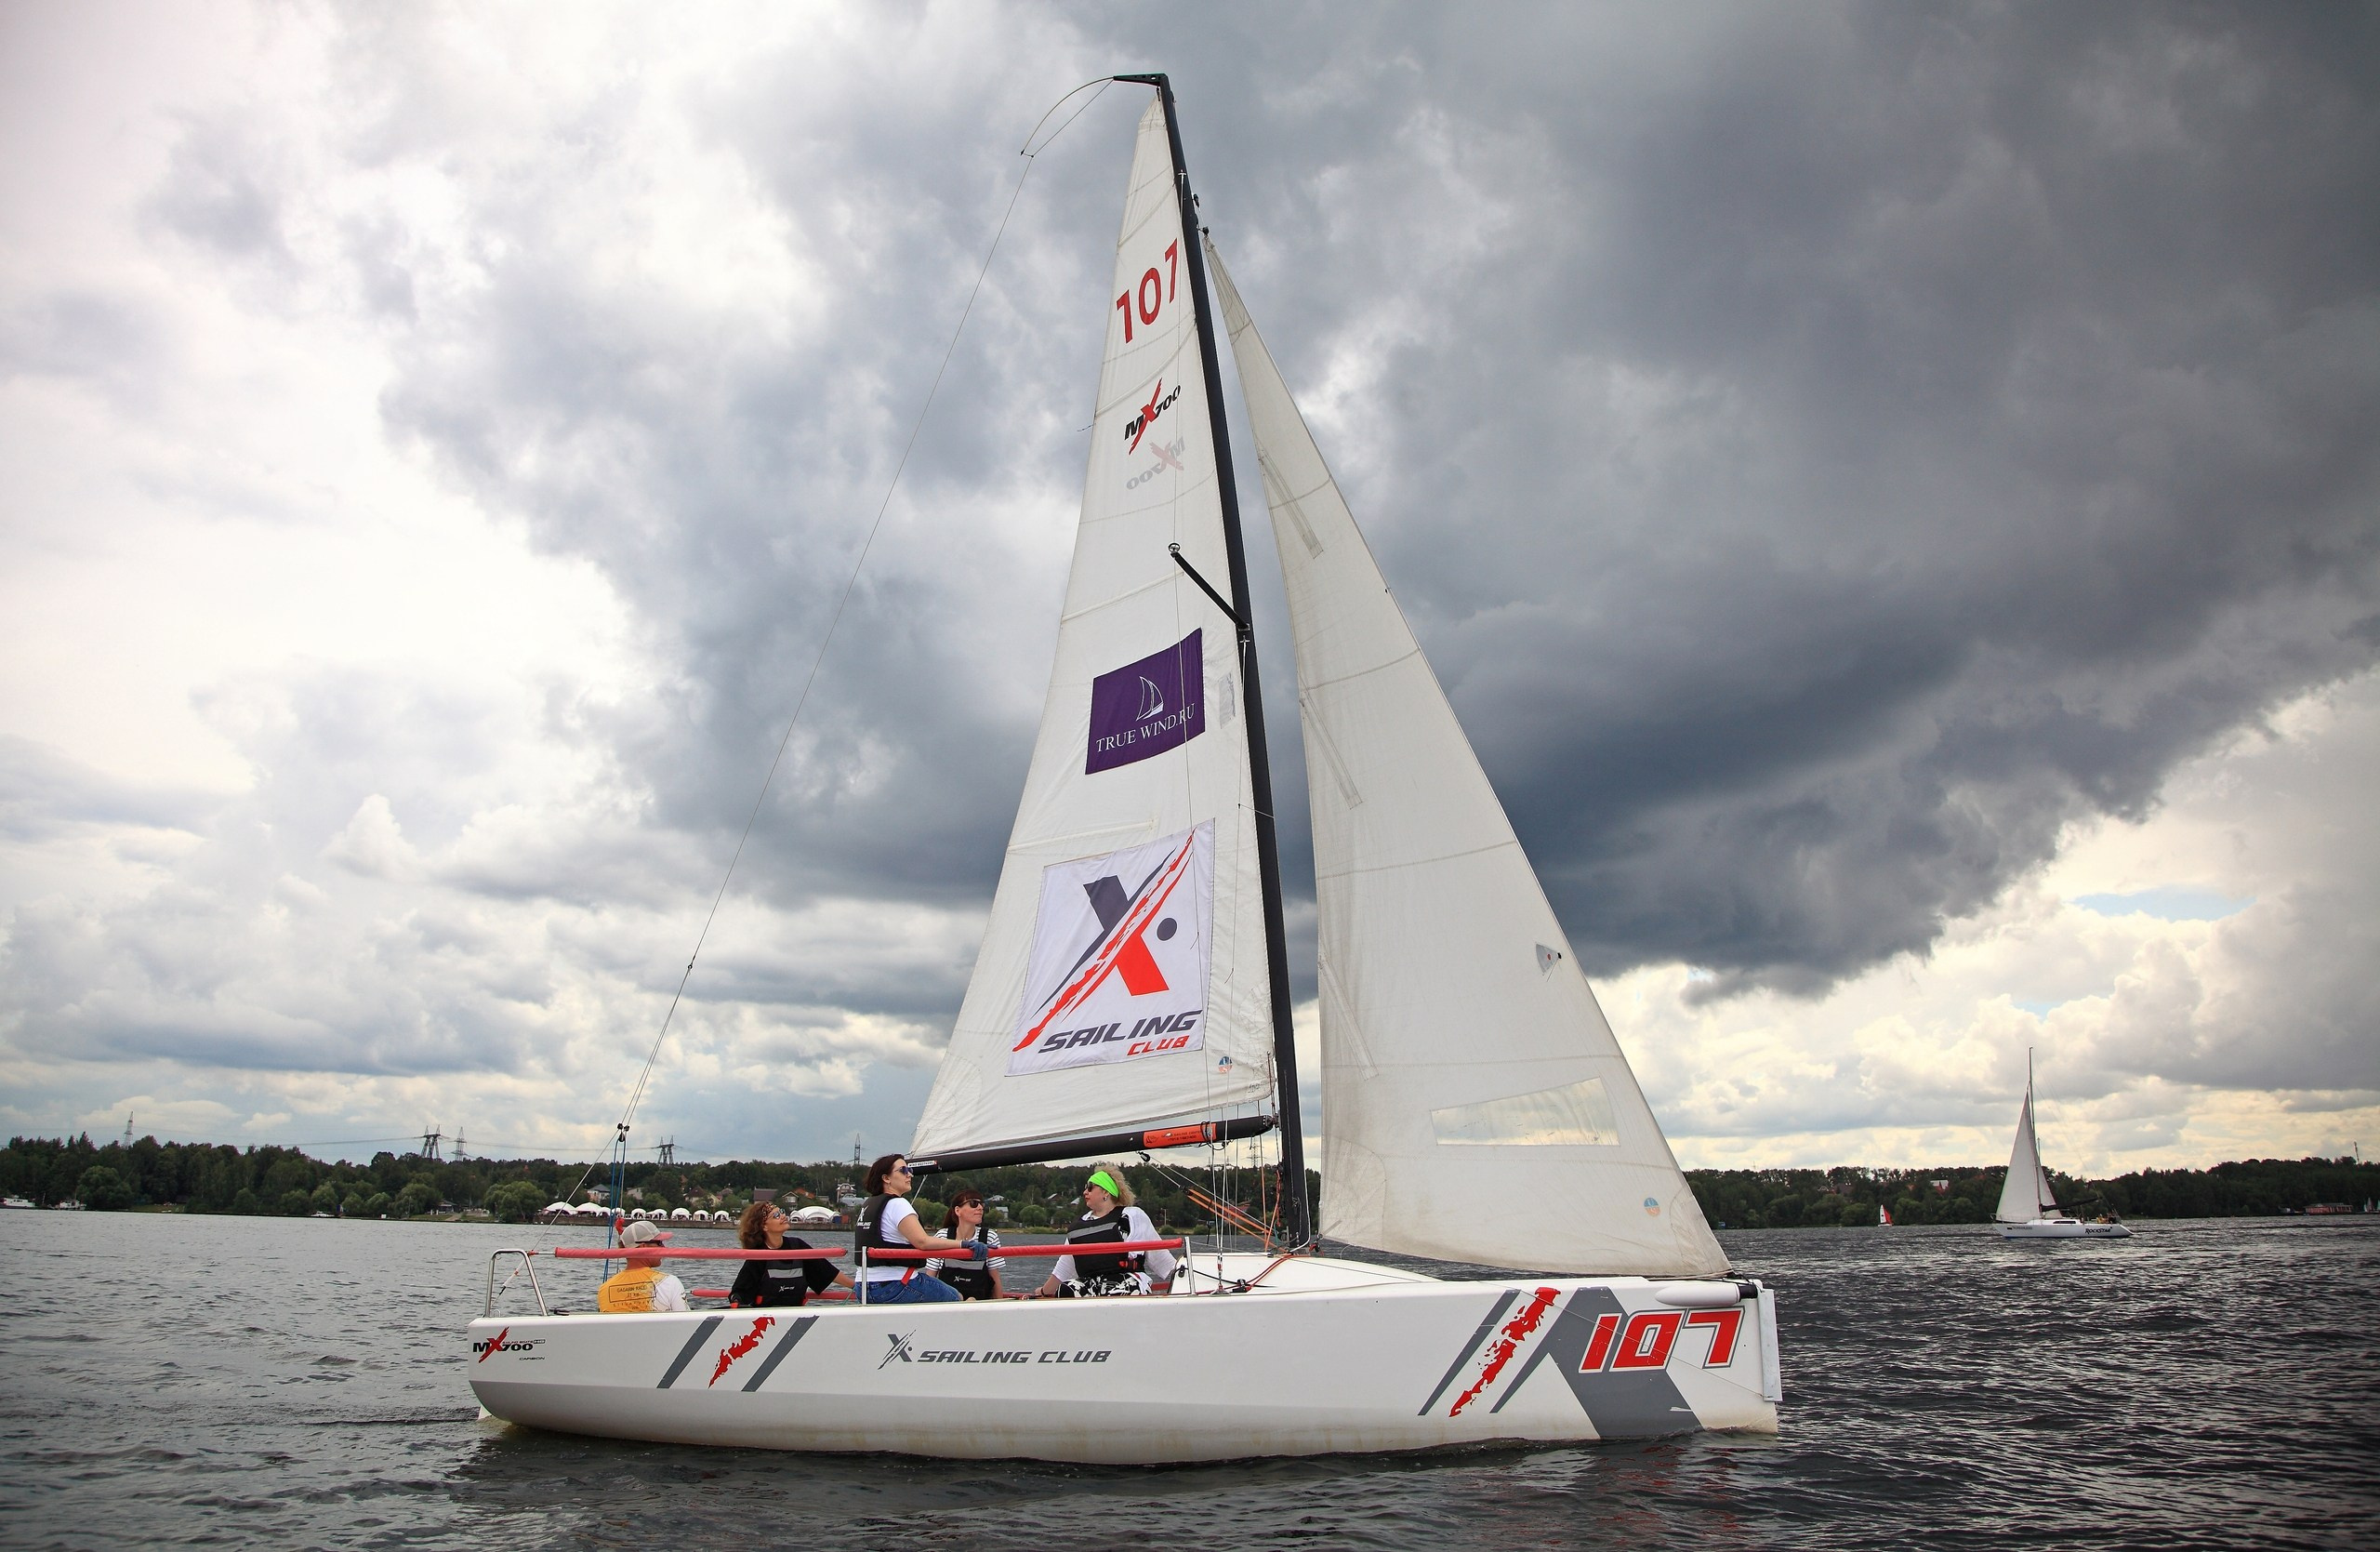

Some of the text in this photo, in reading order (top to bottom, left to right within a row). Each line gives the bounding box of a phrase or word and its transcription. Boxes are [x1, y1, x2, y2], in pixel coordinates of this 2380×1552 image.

[1116, 237, 1178, 344] 107
[1123, 377, 1182, 456] MX700
[1095, 703, 1196, 752] TRUE WIND.RU
[1038, 1009, 1203, 1055] SAILING
[1127, 1035, 1190, 1056] CLUB
[2085, 1227, 2112, 1235] ROCKSTAR
[472, 1326, 534, 1364] MX700
[917, 1350, 1033, 1363] SAILING
[1037, 1350, 1112, 1363] CLUB
[1578, 1305, 1746, 1373] 107
